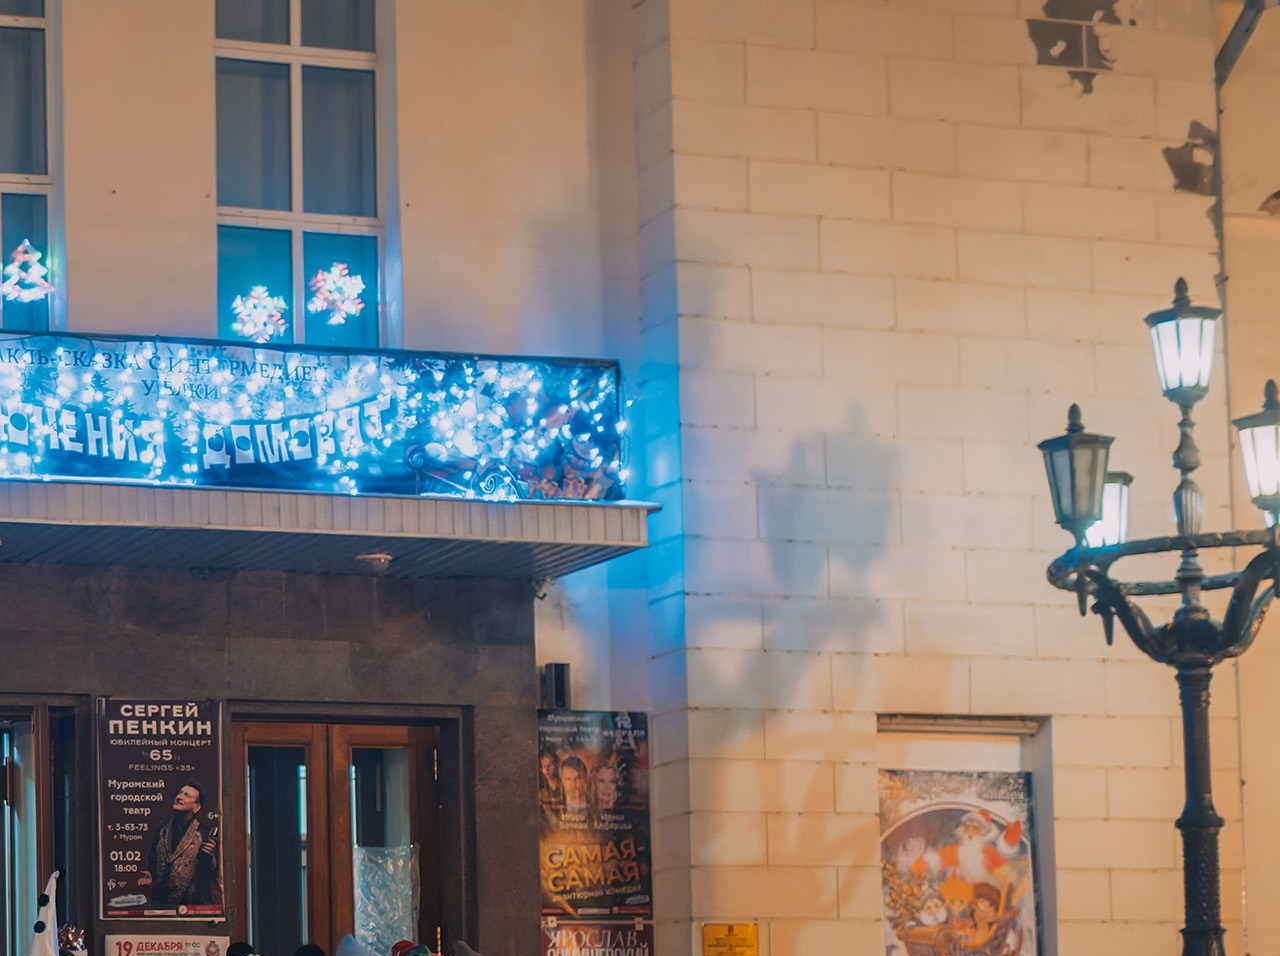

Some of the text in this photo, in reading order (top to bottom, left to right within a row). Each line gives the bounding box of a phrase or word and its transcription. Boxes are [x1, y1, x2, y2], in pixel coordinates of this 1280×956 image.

[120, 702, 199, 718] СЕРГЕЙ
[109, 720, 212, 735] ПЕНКИН
[108, 779, 165, 790] Муромский
[111, 793, 163, 802] городской
[123, 807, 151, 816] театр
[109, 851, 141, 861] 01.02
[114, 864, 138, 872] 18:00
[547, 862, 640, 892] САМАЯ
[116, 941, 133, 956] 19
[136, 941, 182, 952] ДЕКАБРЯ
